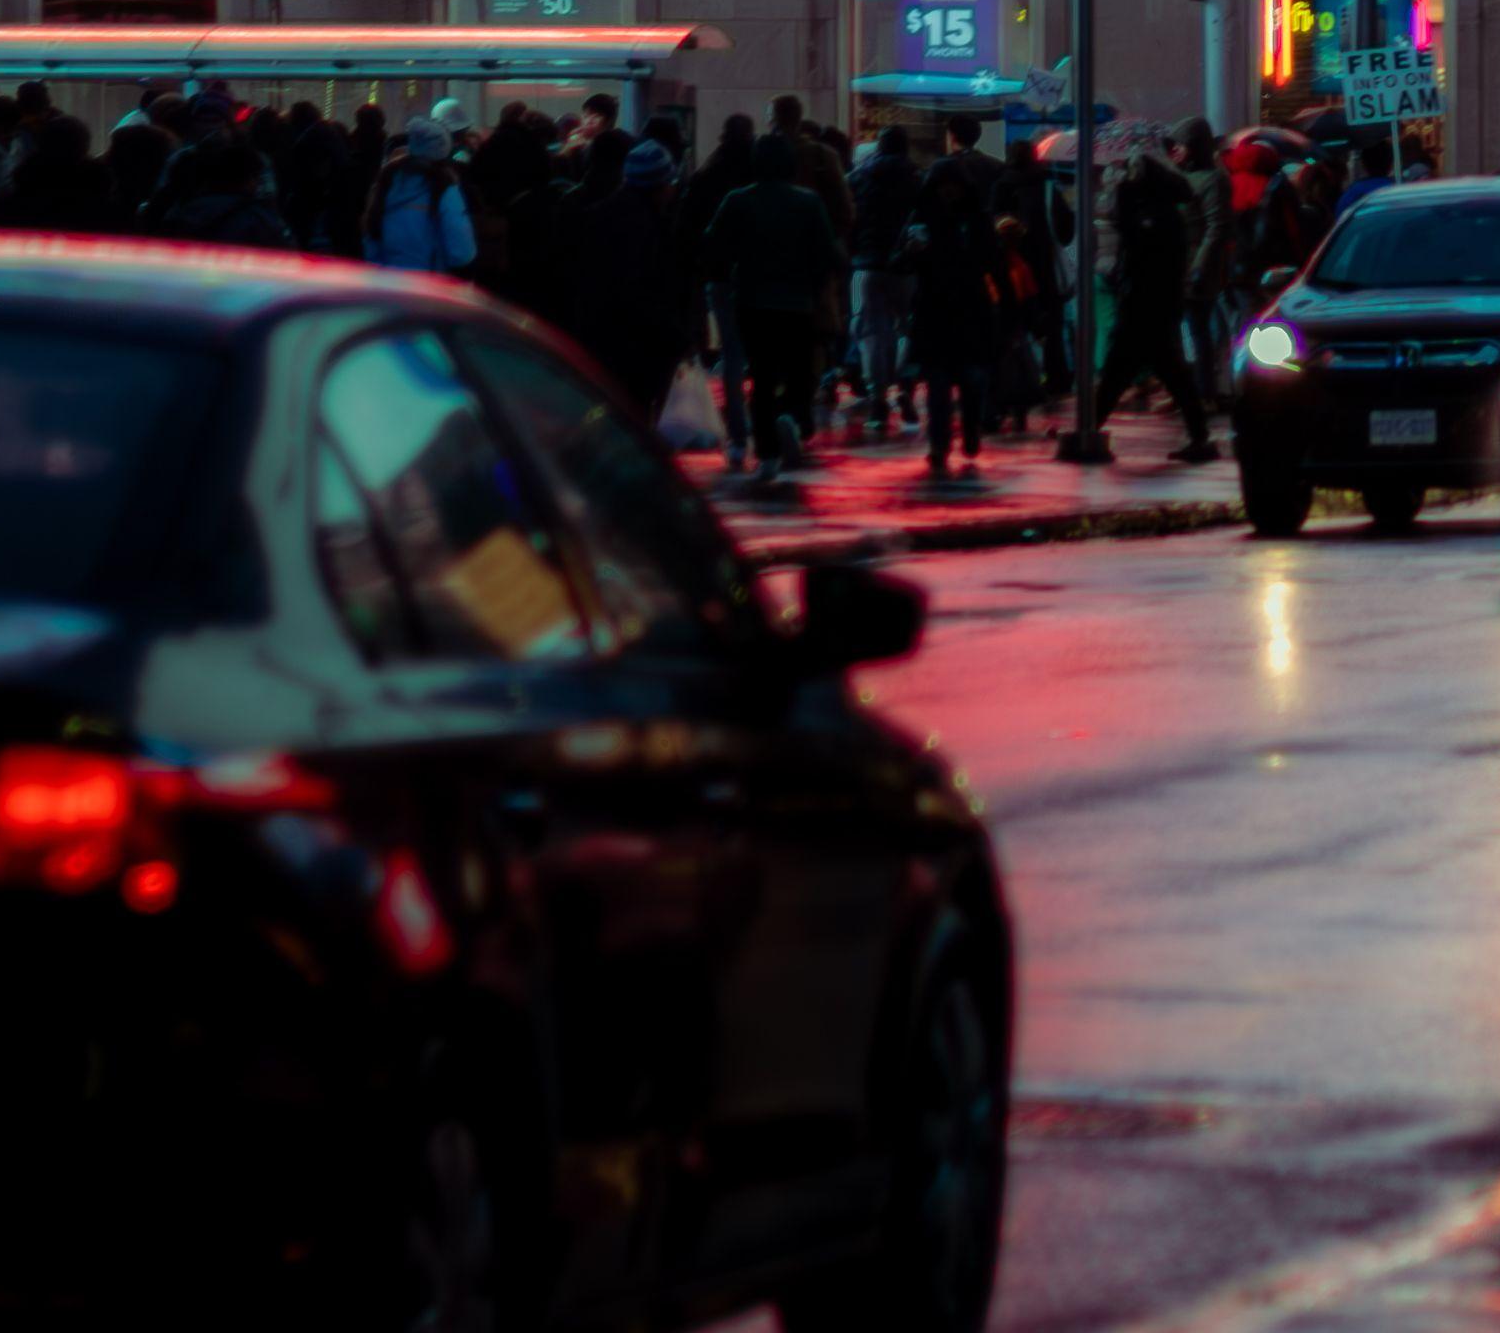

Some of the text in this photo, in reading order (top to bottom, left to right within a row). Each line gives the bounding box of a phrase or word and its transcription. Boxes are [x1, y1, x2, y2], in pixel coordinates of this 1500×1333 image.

[906, 8, 976, 47] $15
[1346, 49, 1435, 75] FREE
[1353, 71, 1431, 91] INFO ON
[1350, 87, 1441, 120] ISLAM
